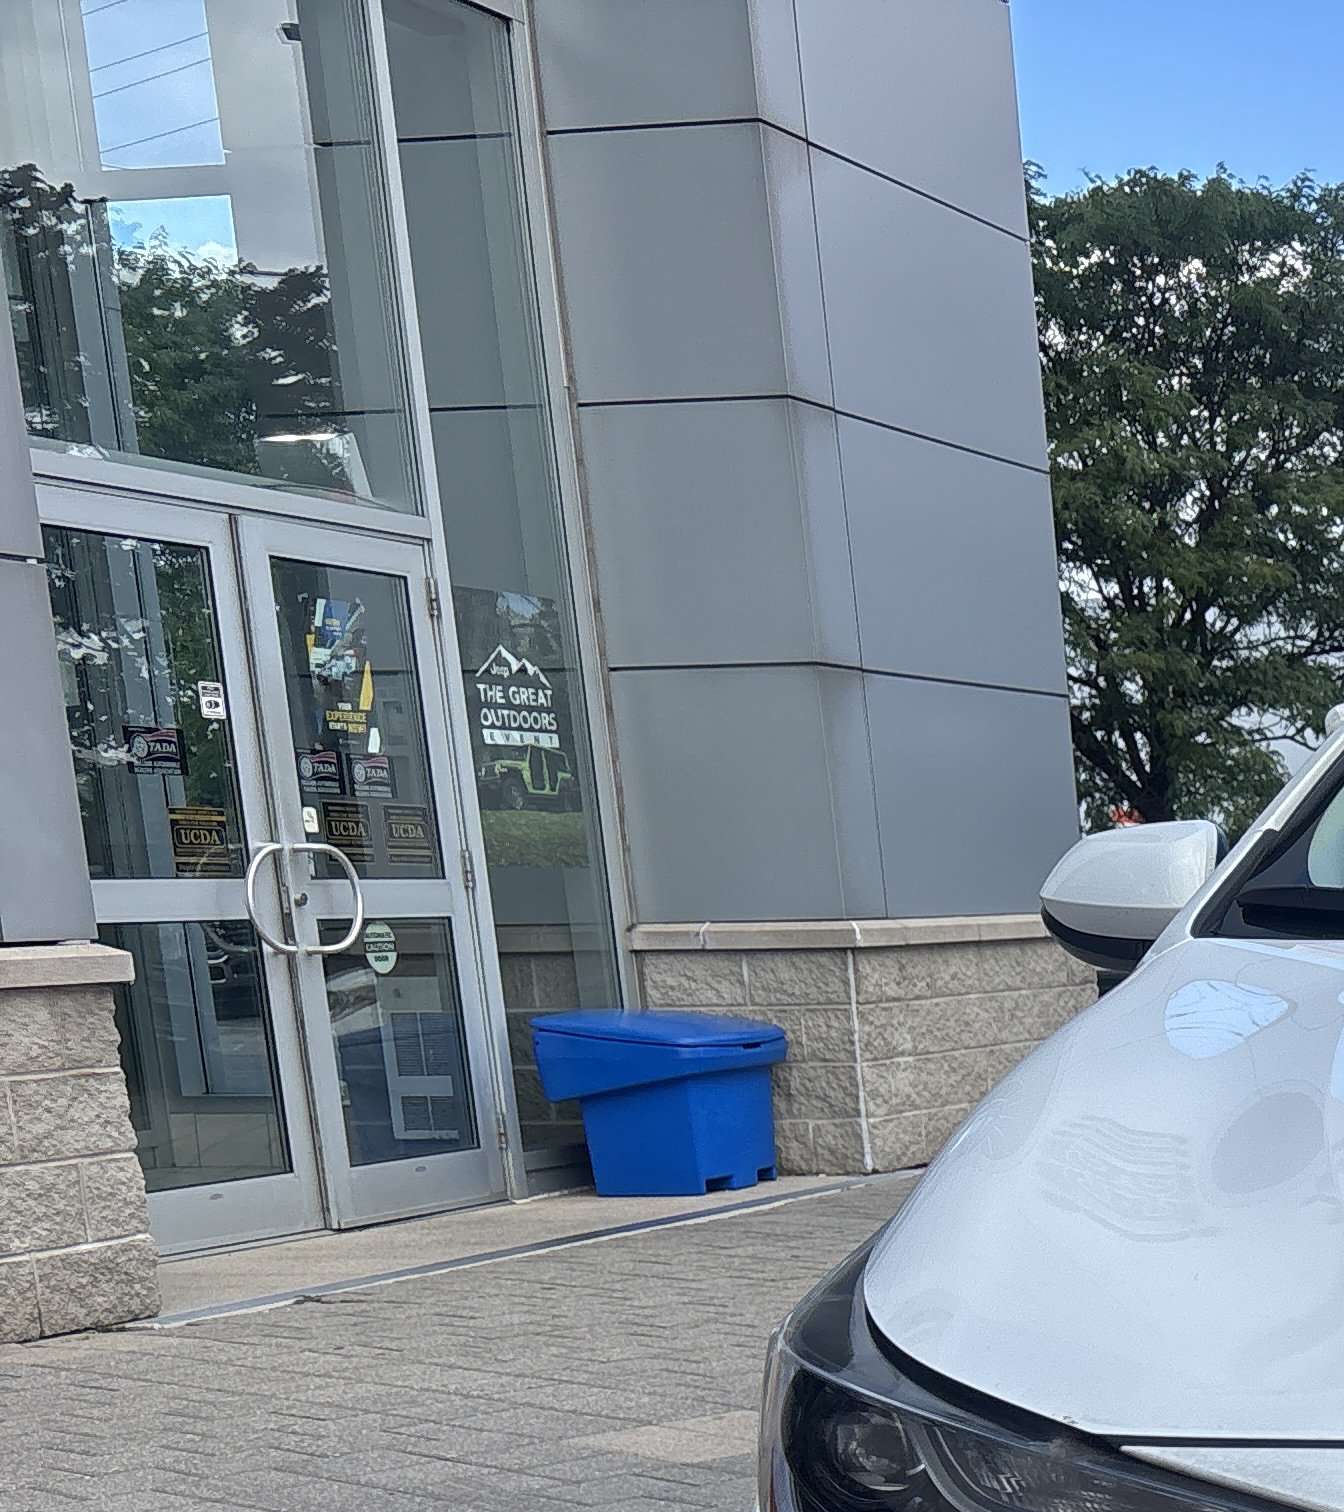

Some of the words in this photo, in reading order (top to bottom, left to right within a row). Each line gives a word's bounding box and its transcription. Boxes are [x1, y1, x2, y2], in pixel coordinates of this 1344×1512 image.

[476, 683, 505, 704] THE
[509, 686, 552, 707] GREAT
[480, 707, 557, 730] OUTDOORS
[489, 731, 554, 744] EVENT
[147, 741, 177, 754] TADA
[332, 821, 367, 836] UCDA
[391, 823, 424, 838] UCDA
[180, 829, 221, 845] UCDA
